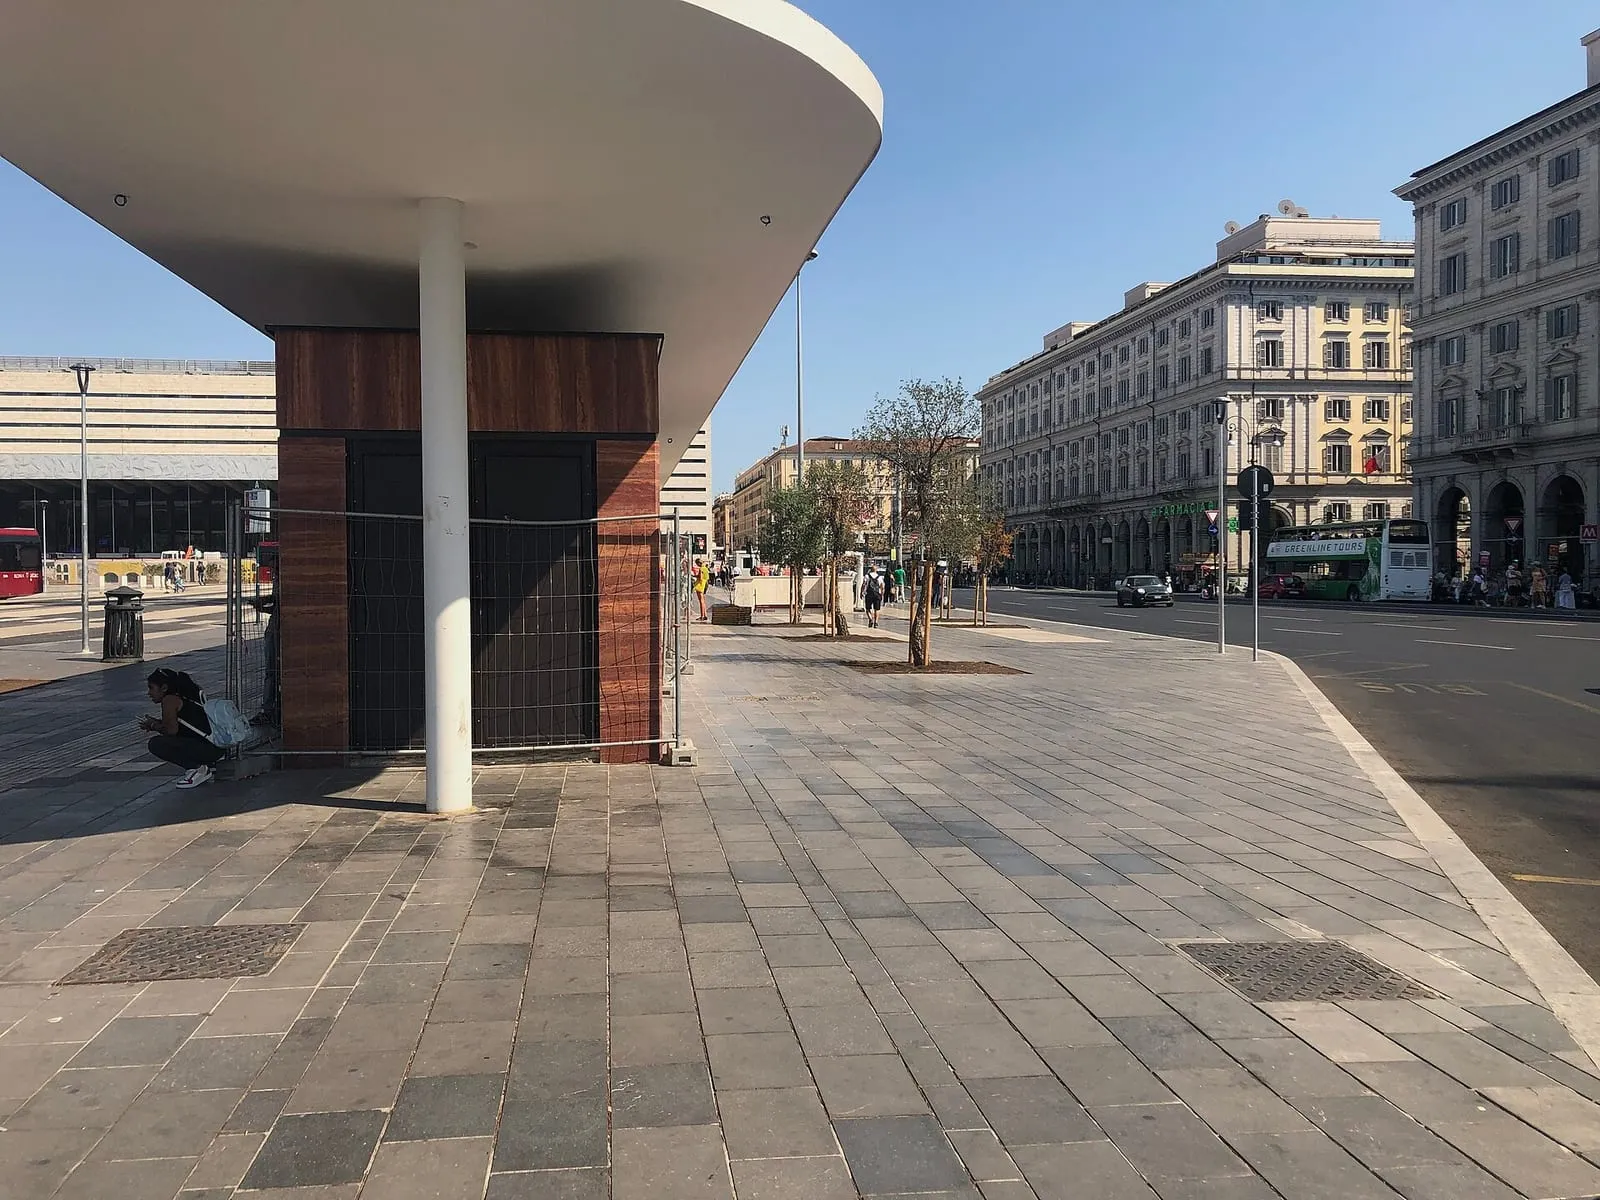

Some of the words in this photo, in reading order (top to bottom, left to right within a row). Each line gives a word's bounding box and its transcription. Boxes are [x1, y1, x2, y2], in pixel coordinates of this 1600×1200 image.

[1159, 502, 1205, 516] FARMACIA
[1284, 543, 1332, 553] GREENLINE
[1333, 541, 1363, 552] TOURS
[1356, 681, 1489, 696] BUS
